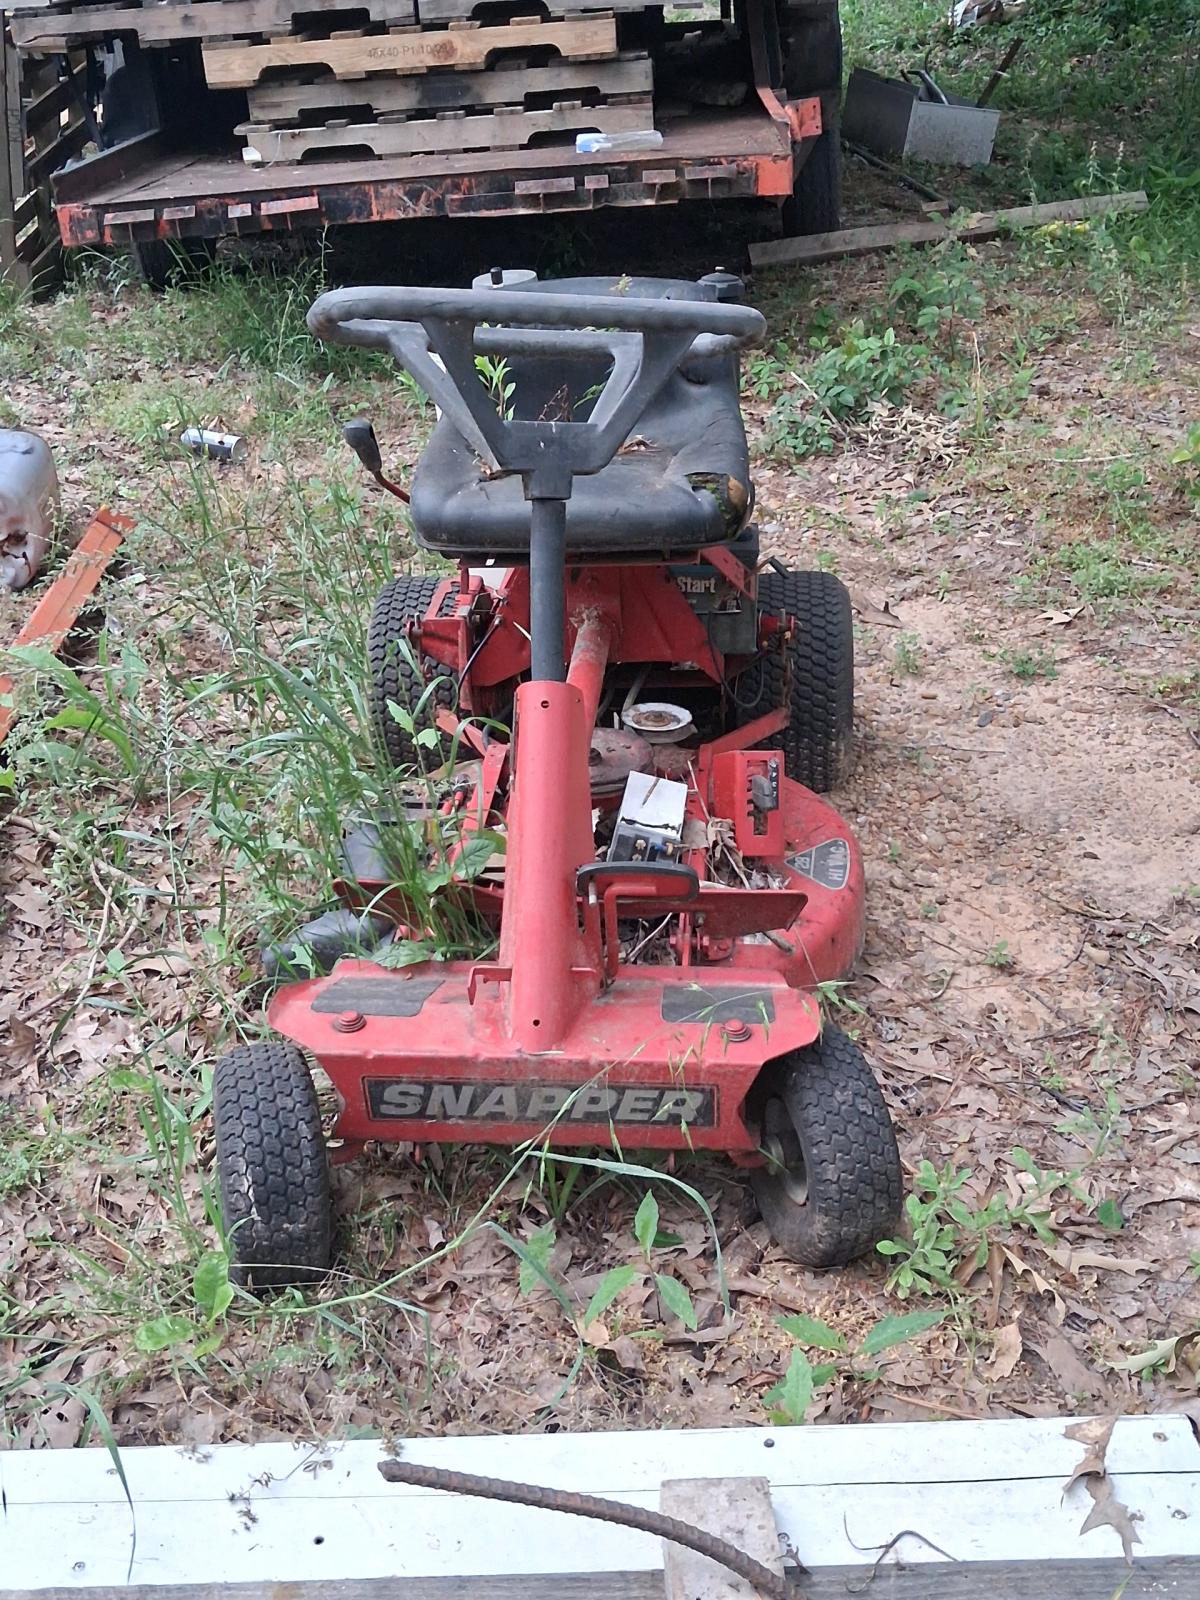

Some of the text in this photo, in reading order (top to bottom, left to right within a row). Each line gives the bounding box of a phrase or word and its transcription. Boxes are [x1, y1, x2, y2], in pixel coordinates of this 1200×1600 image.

[677, 576, 715, 593] Start
[794, 856, 810, 869] 28
[828, 868, 844, 881] HI
[379, 1083, 704, 1122] SNAPPER
